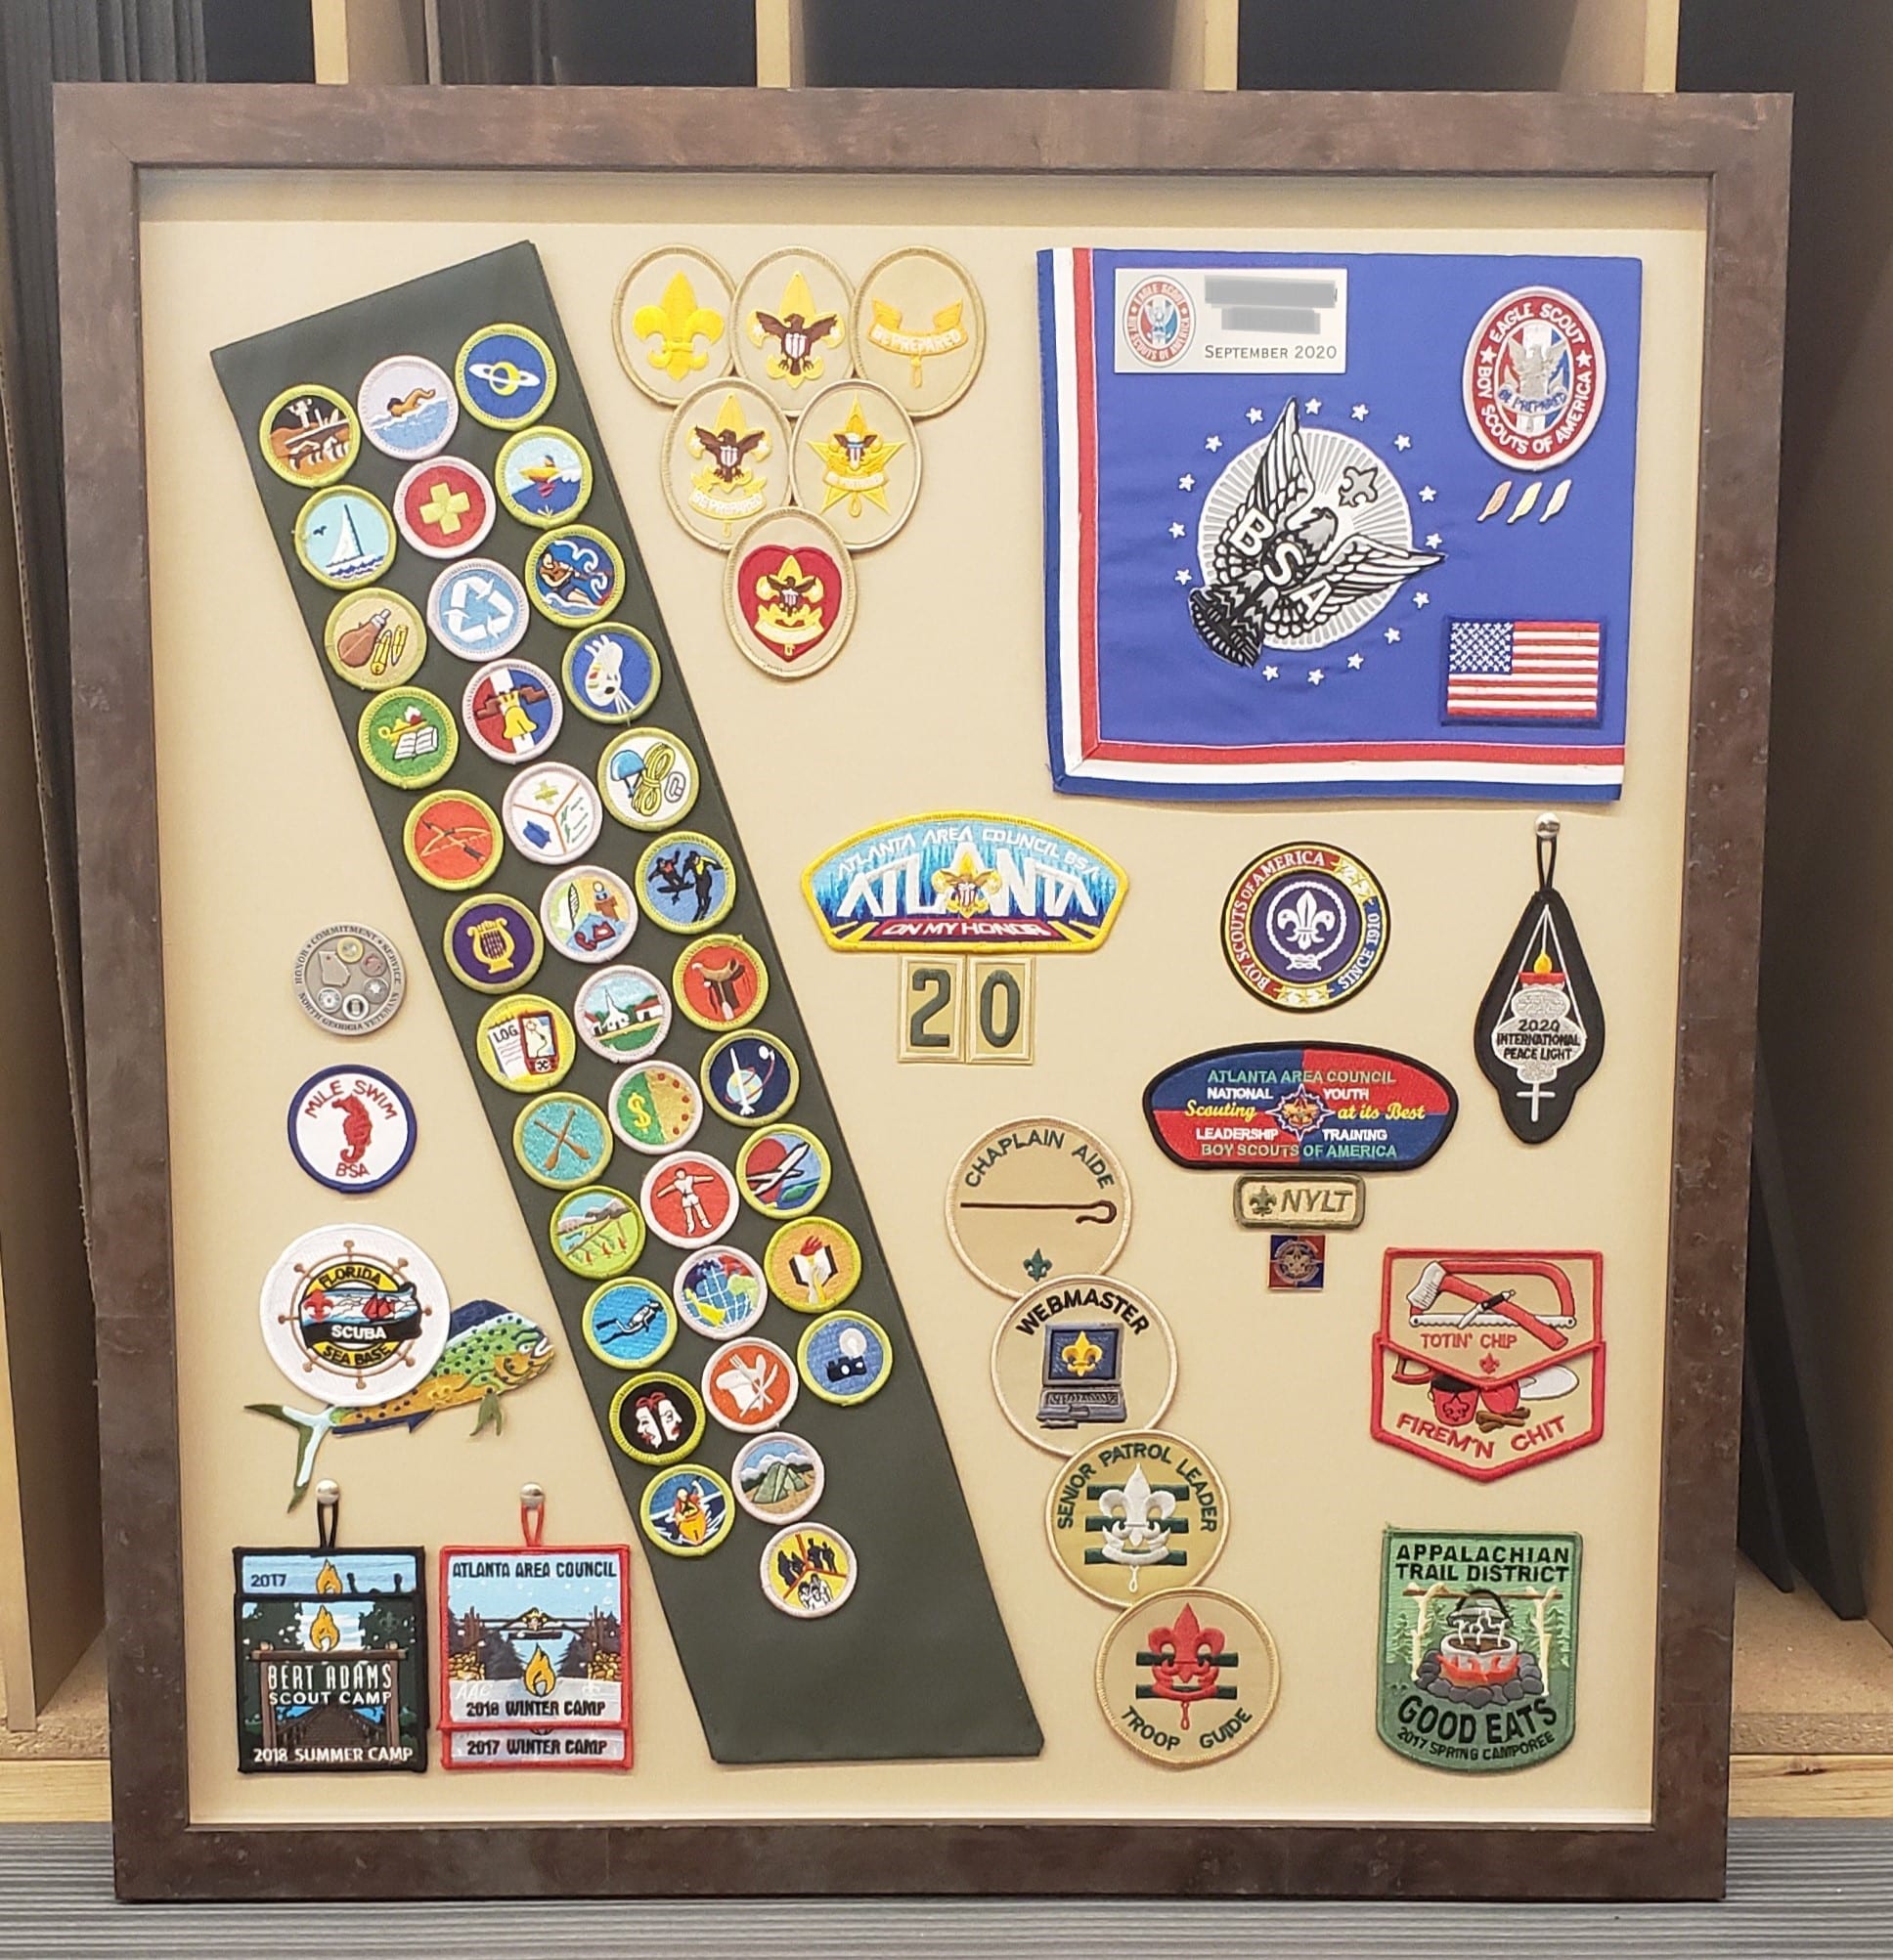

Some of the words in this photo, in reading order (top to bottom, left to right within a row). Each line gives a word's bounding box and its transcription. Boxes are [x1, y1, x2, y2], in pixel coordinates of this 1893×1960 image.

[1489, 303, 1534, 344] EAGLE
[1539, 303, 1586, 345] SCOUT
[1205, 344, 1289, 360] SEPTEMBER
[1294, 345, 1338, 360] 2020
[1476, 366, 1494, 400] BOY
[1555, 370, 1593, 445] AMERICA
[1480, 404, 1529, 455] SCOUTS
[1532, 438, 1554, 455] OF
[836, 832, 916, 879] ATLANTA
[922, 825, 974, 845] AREA
[982, 827, 1059, 859] COUNCIL
[1064, 850, 1100, 878] BSA
[1254, 849, 1326, 888] AMERICA
[836, 842, 1098, 918] ATLANTA
[1240, 881, 1257, 900] OF
[882, 922, 920, 936] ON
[922, 922, 956, 936] MY
[961, 922, 1052, 937] HONOR
[1230, 899, 1251, 962] SCOUTS
[294, 949, 310, 984] HONOR
[310, 925, 378, 946] COMMITMENT
[381, 942, 402, 985] SERVICE
[1338, 947, 1375, 990] SINCE
[1365, 912, 1382, 946] 1910
[1242, 961, 1271, 991] BOY
[298, 991, 322, 1022] NORTH
[321, 1017, 364, 1031] GEORGIA
[492, 1024, 519, 1044] LOG
[1518, 1019, 1561, 1032] 2020
[1496, 1032, 1581, 1047] INTERNATIONAL
[1503, 1047, 1538, 1061] PEACE
[1540, 1048, 1572, 1061] LIGHT
[1207, 1069, 1277, 1084] ATLANTA
[1280, 1069, 1322, 1084] AREA
[1326, 1070, 1395, 1084] COUNCIL
[304, 1079, 344, 1119] MILE
[352, 1079, 398, 1120] SWIM
[1207, 1087, 1274, 1100] NATIONAL
[1322, 1088, 1369, 1100] YOUTH
[1184, 1099, 1257, 1122] Scouting
[1337, 1104, 1357, 1120] at
[1359, 1106, 1380, 1120] its
[1385, 1102, 1426, 1120] Best
[1196, 1127, 1279, 1141] LEADERSHIP
[1322, 1128, 1387, 1142] TRAINING
[964, 1128, 1066, 1189] CHAPLAIN
[1071, 1143, 1116, 1190] AIDE
[1202, 1144, 1234, 1157] BOY
[1237, 1144, 1300, 1157] SCOUTS
[1302, 1145, 1323, 1157] OF
[1328, 1145, 1398, 1158] AMERICA
[335, 1161, 371, 1179] BSA
[1279, 1189, 1353, 1213] NYLT
[318, 1266, 382, 1289] FLORIDA
[1015, 1287, 1151, 1336] WEBMASTER
[330, 1325, 387, 1340] SCUBA
[1420, 1332, 1474, 1349] TOTIN'
[1479, 1332, 1518, 1349] CHIP
[322, 1346, 351, 1366] SEA
[354, 1344, 391, 1366] BASE
[1510, 1415, 1565, 1452] CHIT
[1057, 1462, 1097, 1530] SENIOR
[1097, 1442, 1172, 1467] PATROL
[1175, 1458, 1218, 1533] LEADER
[1395, 1544, 1569, 1564] APPALACHIAN
[250, 1573, 287, 1589] 2017
[452, 1561, 510, 1579] ATLANTA
[514, 1562, 550, 1578] AREA
[555, 1561, 618, 1578] COUNCIL
[1395, 1562, 1459, 1581] TRAIL
[1467, 1564, 1569, 1583] DISTRICT
[268, 1663, 315, 1691] BERT
[326, 1663, 393, 1690] ADAMS
[268, 1691, 335, 1706] SCOUT
[339, 1691, 393, 1706] CAMP
[456, 1681, 495, 1701] AAC
[465, 1701, 500, 1718] 2018
[506, 1700, 559, 1718] WINTER
[563, 1701, 606, 1718] CAMP
[1397, 1694, 1477, 1745] GOOD
[1485, 1697, 1558, 1745] EATS
[1121, 1704, 1181, 1752] TROOP
[1199, 1706, 1254, 1751] GUIDE
[466, 1739, 501, 1756] 2017
[506, 1739, 560, 1756] WINTER
[565, 1739, 607, 1756] CAMP
[1396, 1726, 1429, 1751] 2017
[1429, 1741, 1478, 1761] SPRING
[1482, 1729, 1557, 1761] CAMPOREE
[253, 1747, 288, 1763] 2018
[294, 1747, 365, 1763] SUMMER
[368, 1747, 414, 1763] CAMP
